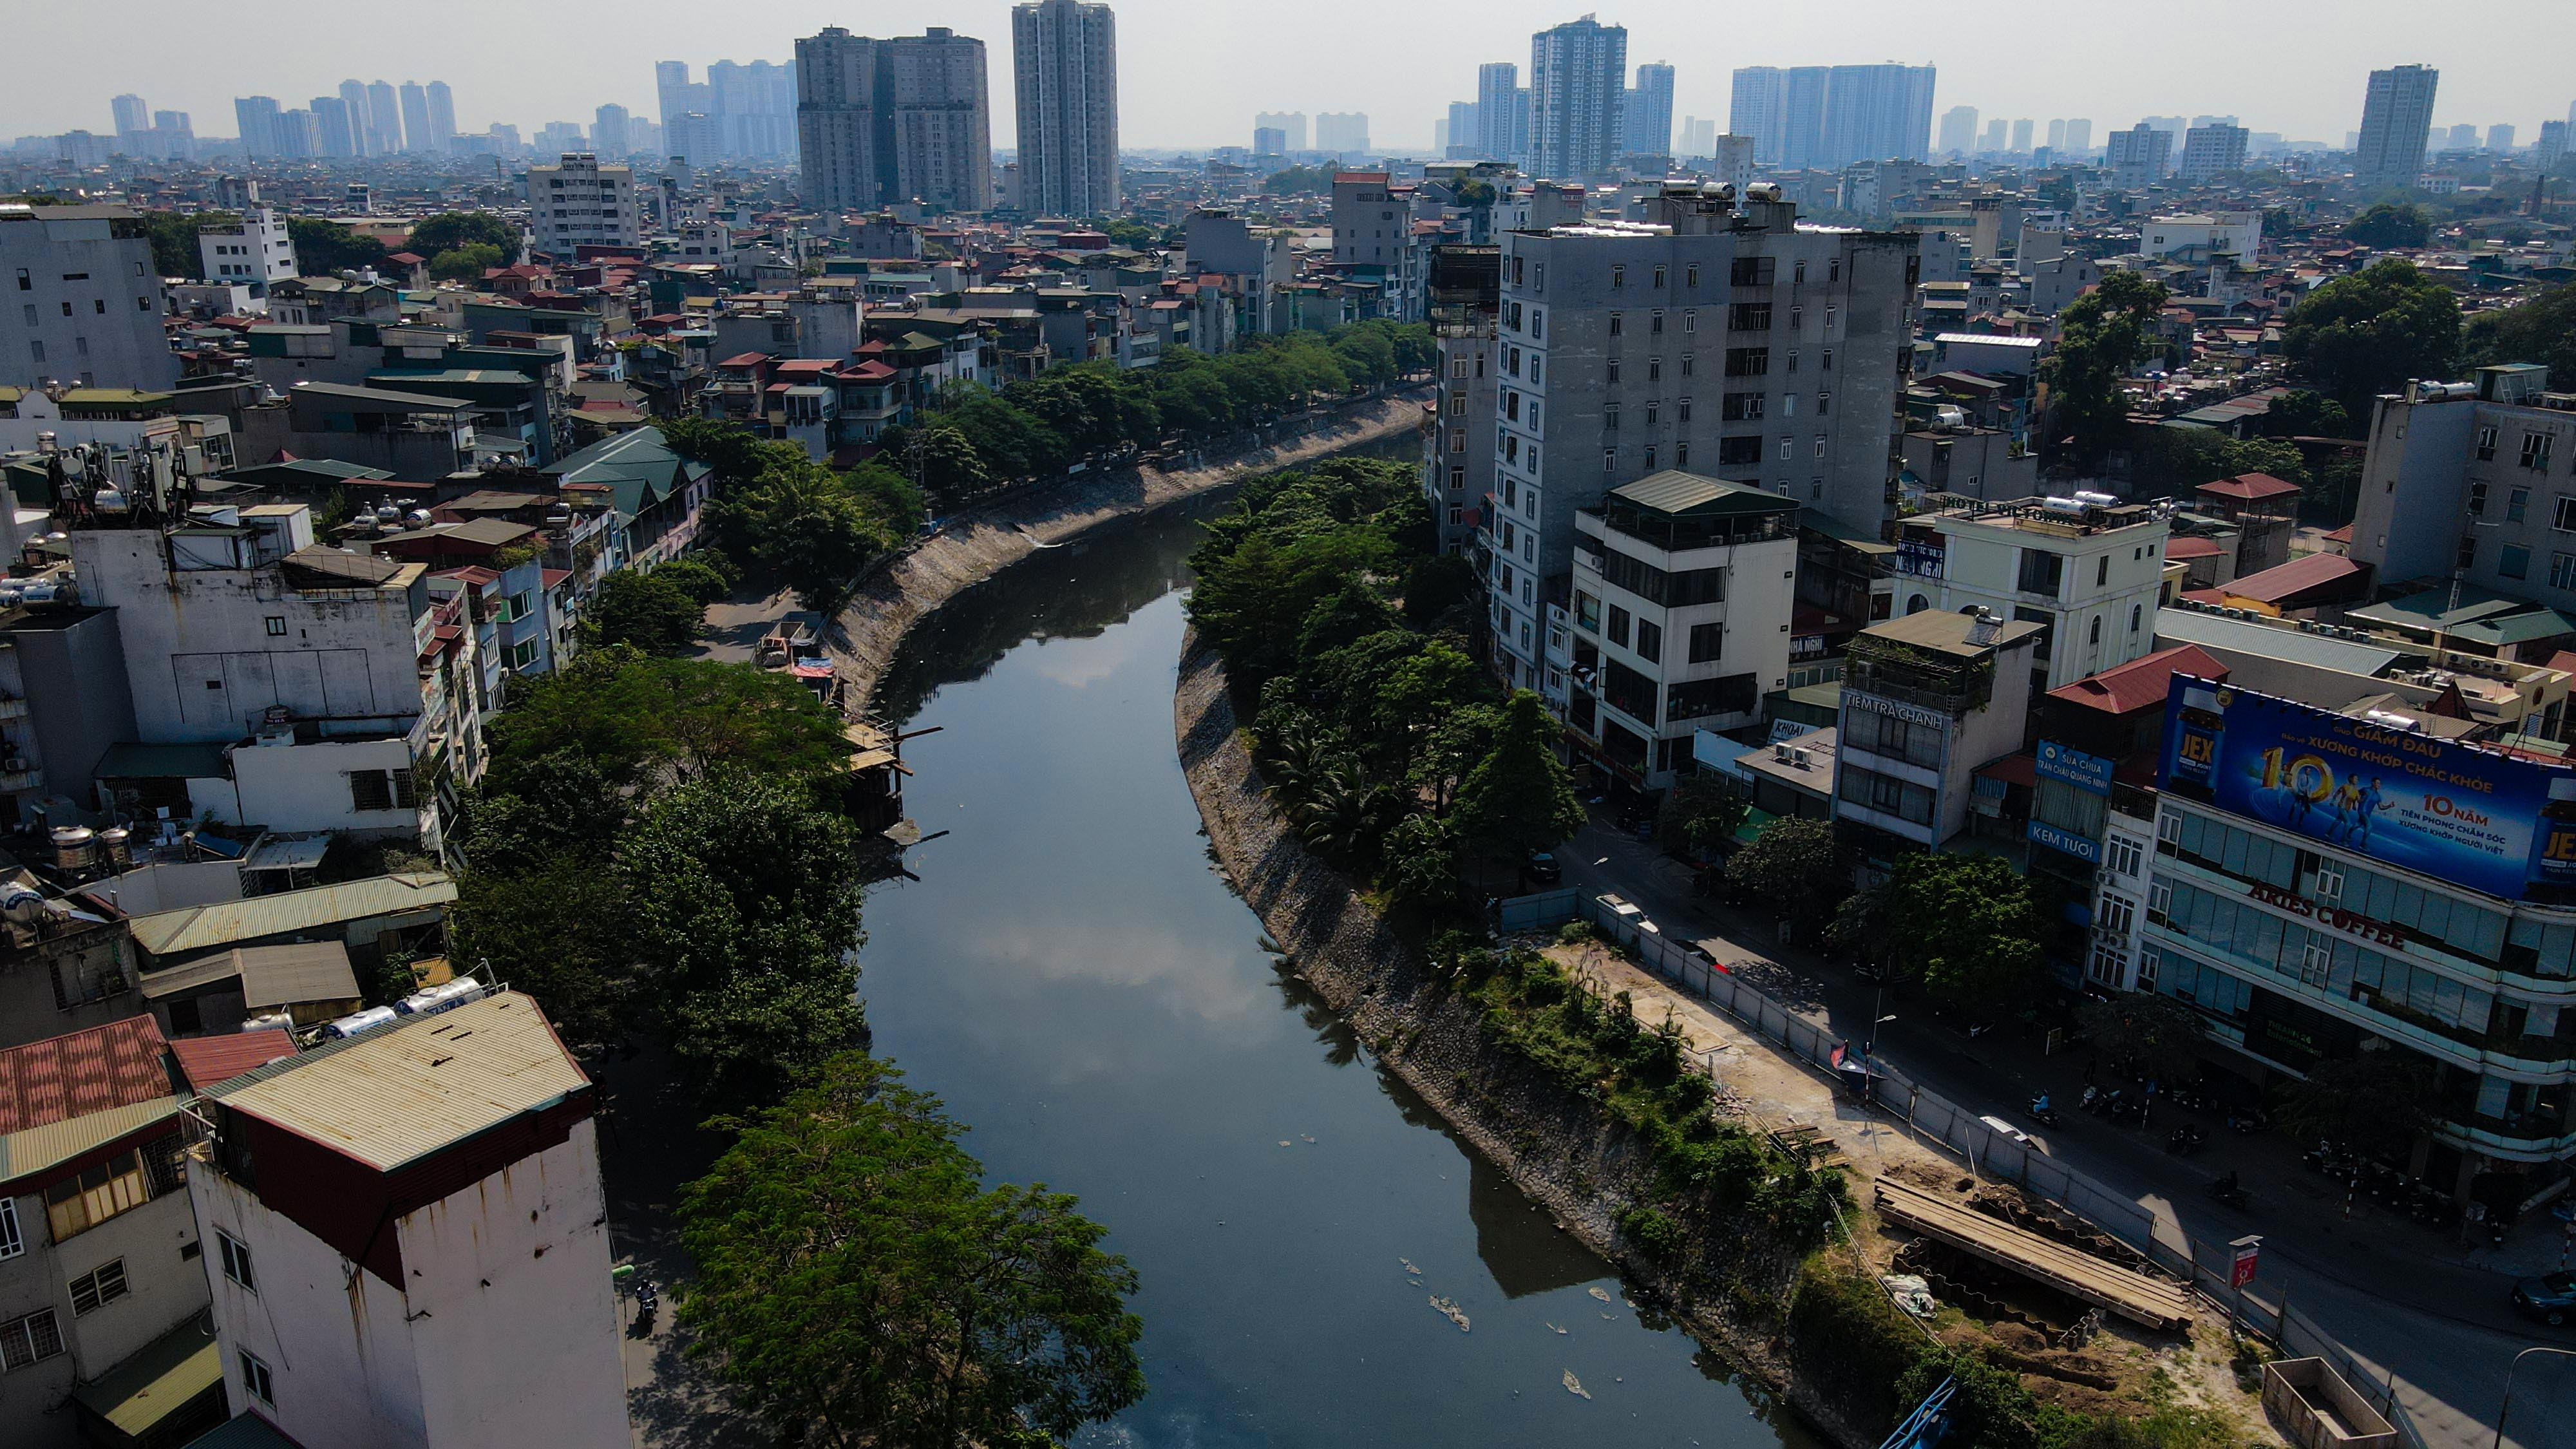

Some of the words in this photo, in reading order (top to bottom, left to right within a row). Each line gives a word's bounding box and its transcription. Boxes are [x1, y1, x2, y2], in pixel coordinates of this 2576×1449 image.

[1898, 708, 1943, 728] CHANH
[1775, 721, 1804, 737] KHOAI
[2180, 734, 2215, 764] JEX
[2079, 760, 2102, 774] CHUA
[2261, 746, 2334, 802] 10
[2423, 793, 2453, 816] 10
[2423, 815, 2455, 830] PHONG
[2033, 826, 2060, 846] KEM
[2543, 832, 2576, 859] JE
[2246, 882, 2315, 917] ARIES
[2316, 905, 2407, 951] COFFEE
